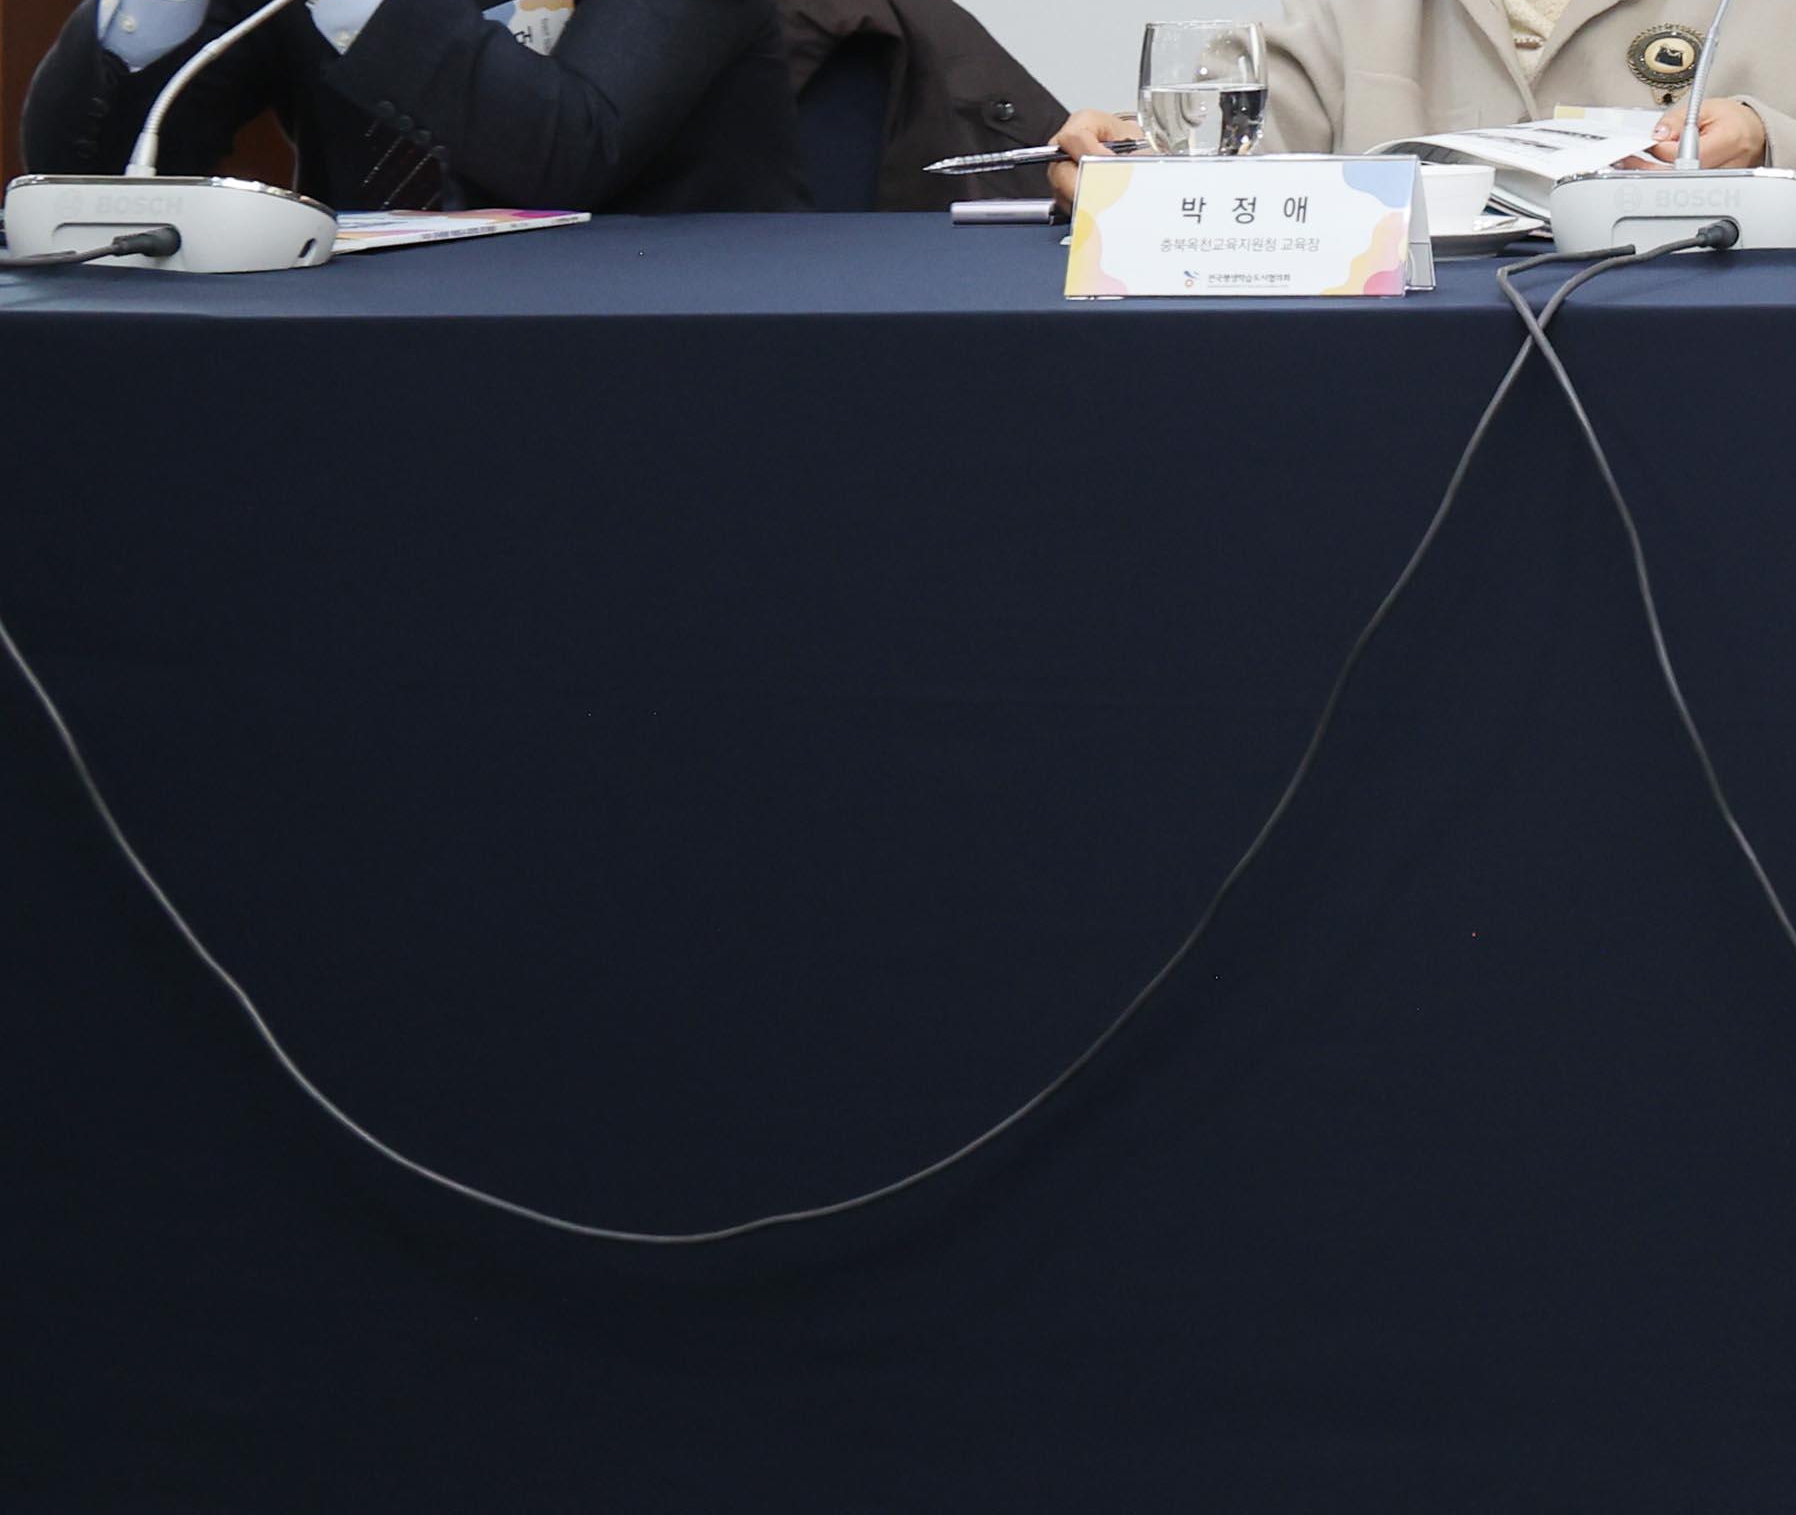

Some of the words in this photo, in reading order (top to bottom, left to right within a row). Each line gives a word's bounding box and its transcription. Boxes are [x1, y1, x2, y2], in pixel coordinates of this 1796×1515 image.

[1655, 189, 1742, 208] BOSCH
[1160, 237, 1277, 252] 충북옥천교육지원청
[1280, 237, 1321, 252] 교육장
